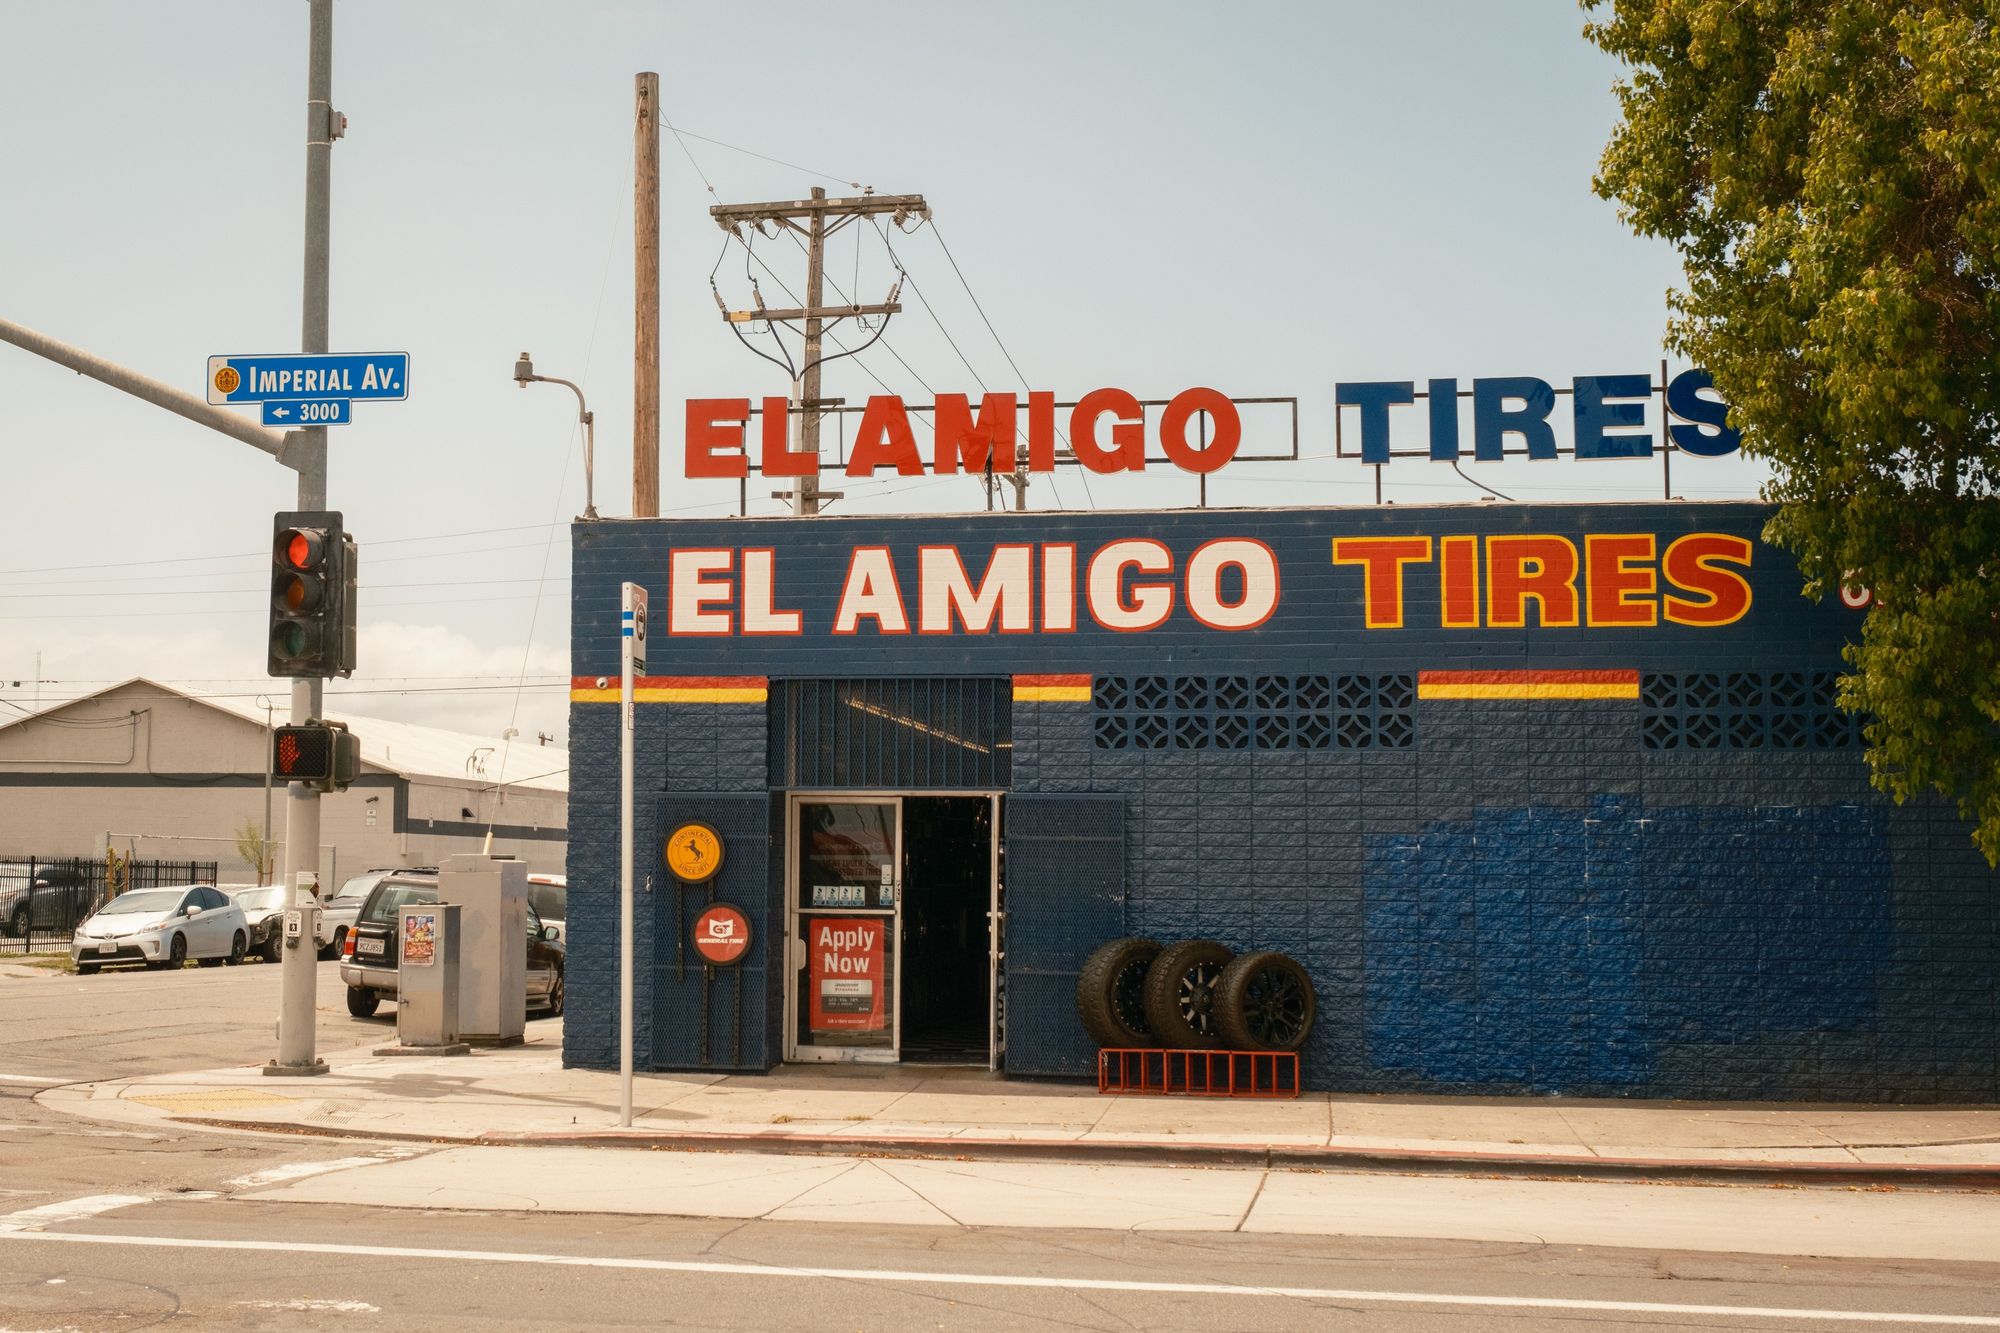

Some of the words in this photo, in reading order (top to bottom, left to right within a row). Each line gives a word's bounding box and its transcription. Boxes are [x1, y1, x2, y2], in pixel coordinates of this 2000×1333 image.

[249, 365, 353, 393] IMPERIAL
[361, 363, 400, 390] AV.
[299, 402, 340, 421] 3000
[685, 396, 819, 478] EL
[845, 387, 1242, 477] AMIGO
[1335, 368, 1742, 464] TIRES
[668, 547, 803, 637] EL
[831, 536, 1281, 635] AMIGO
[1331, 533, 1753, 629] TIRES
[674, 831, 712, 847] CONTINENTAL
[819, 926, 875, 952] Apply
[824, 952, 870, 974] Now
